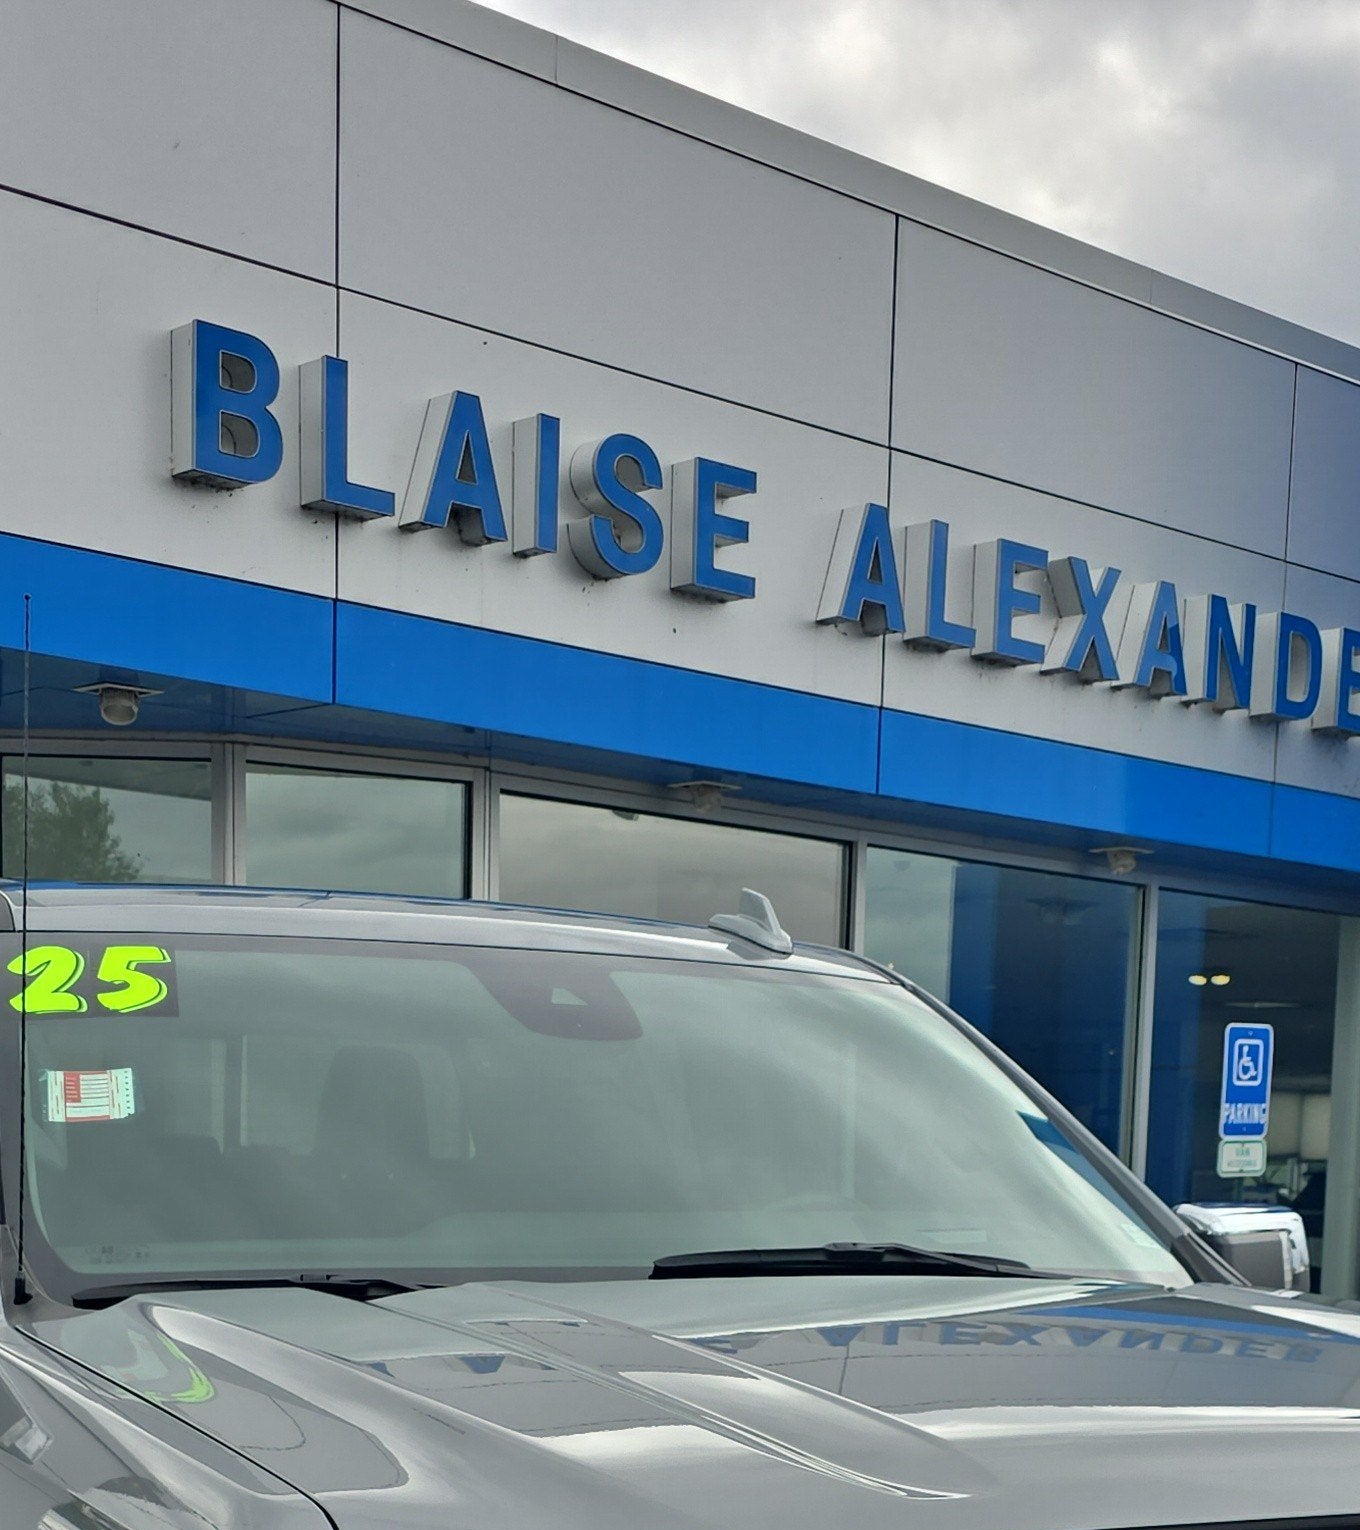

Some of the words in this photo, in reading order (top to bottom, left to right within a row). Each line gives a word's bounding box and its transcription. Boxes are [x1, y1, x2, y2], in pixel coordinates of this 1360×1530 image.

[180, 317, 758, 602] BLAISE
[7, 945, 172, 1013] 25
[1224, 1103, 1268, 1124] PARKING
